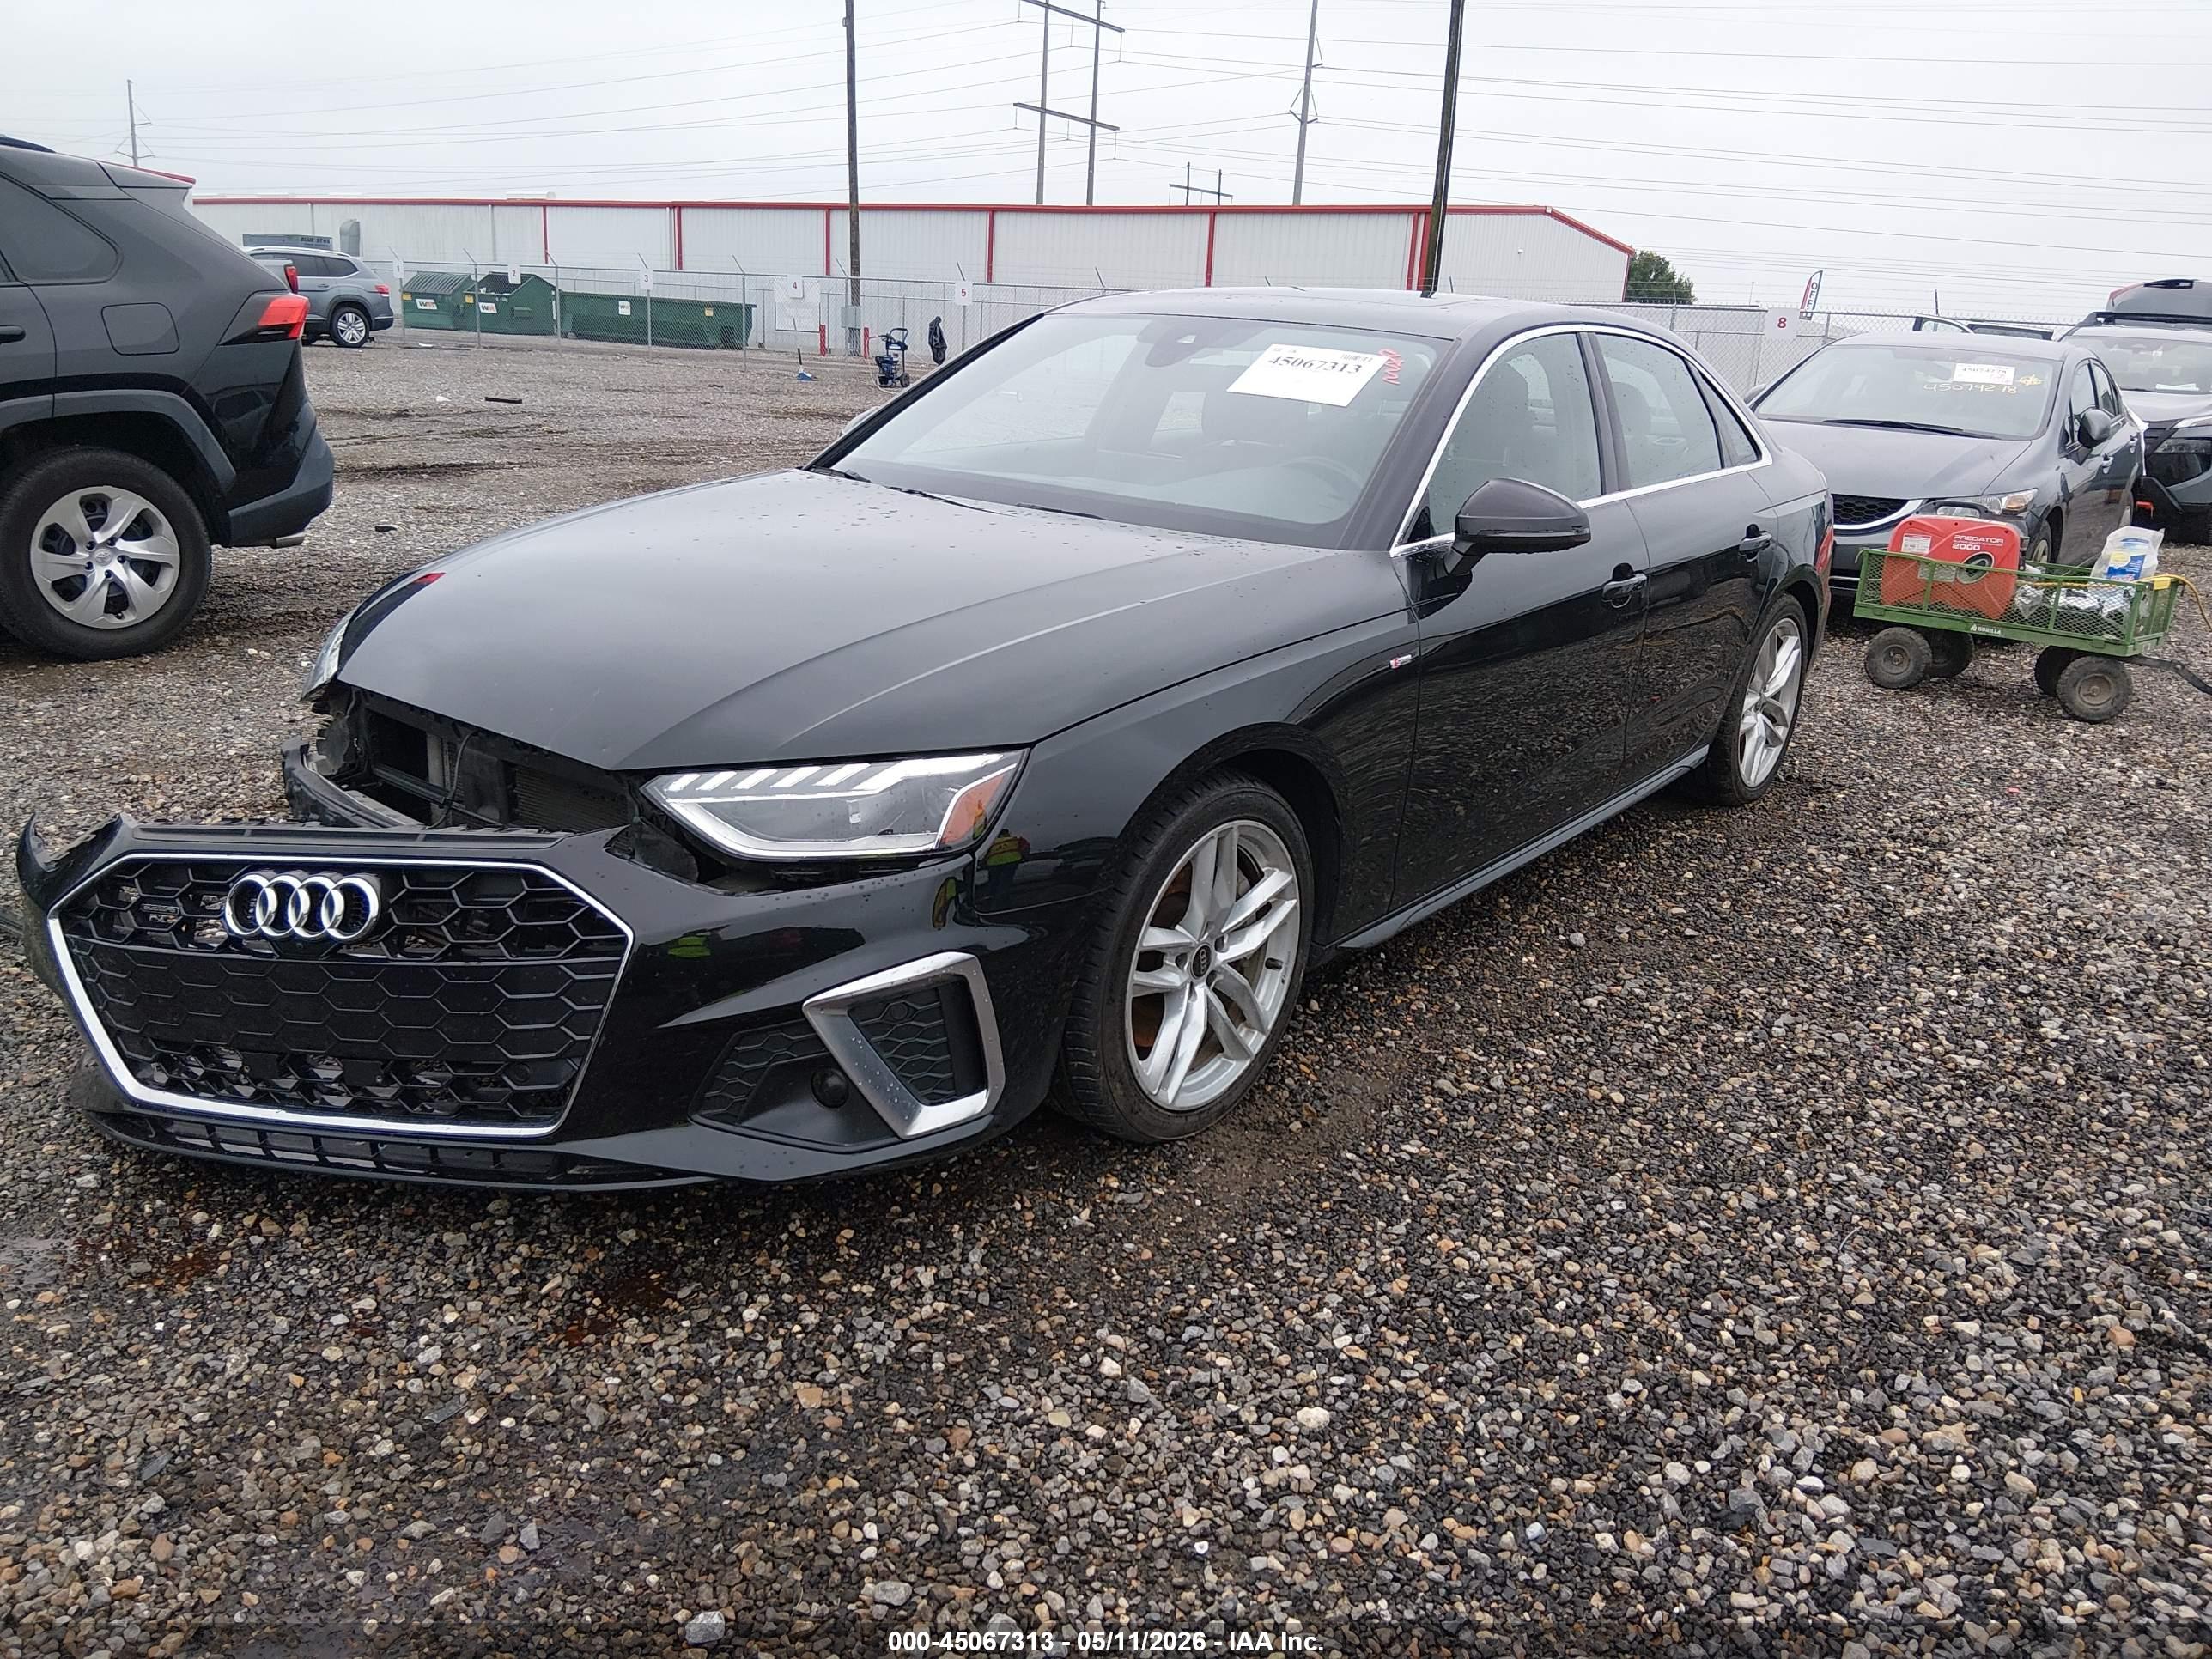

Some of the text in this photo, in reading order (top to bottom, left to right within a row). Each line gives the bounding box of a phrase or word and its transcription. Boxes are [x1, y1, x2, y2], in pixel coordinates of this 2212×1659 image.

[961, 288, 966, 297] 5
[1778, 317, 1787, 328] 8
[1269, 356, 1362, 374] 45067313
[1923, 383, 2017, 394] 45074278
[1953, 534, 2004, 544] PREDATOR
[1978, 626, 2001, 635] GORILLA
